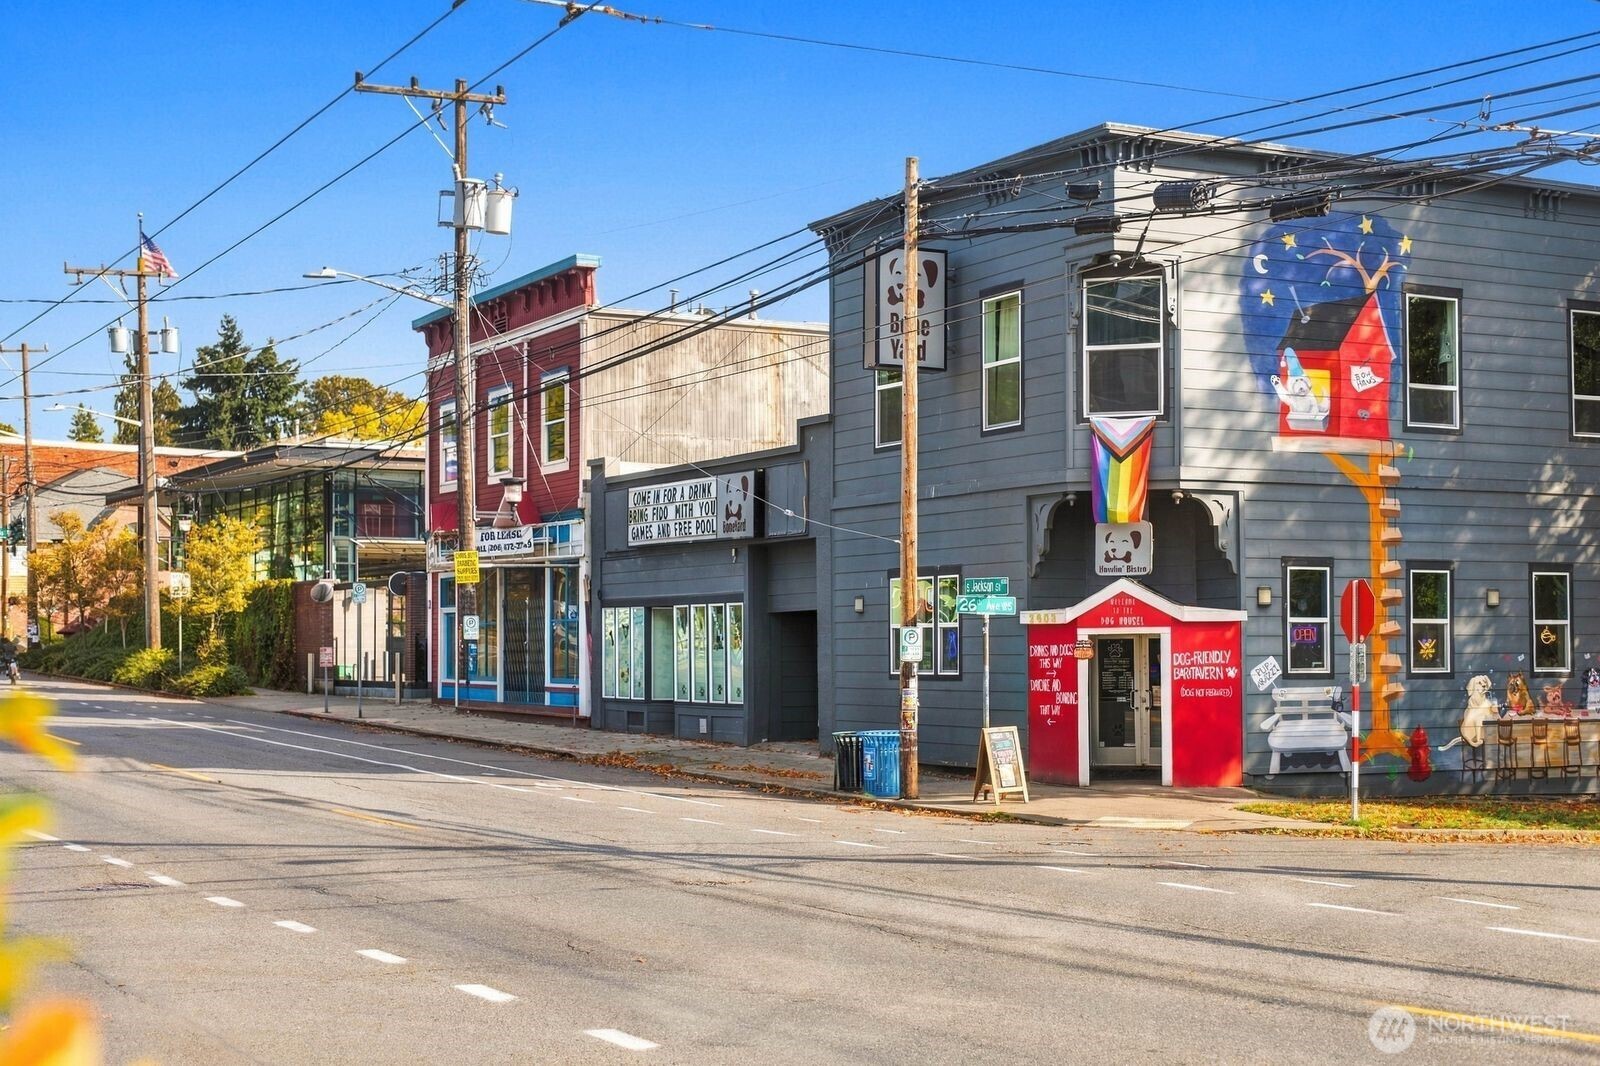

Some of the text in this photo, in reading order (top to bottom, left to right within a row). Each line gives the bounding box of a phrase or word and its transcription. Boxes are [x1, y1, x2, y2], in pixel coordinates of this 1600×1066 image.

[633, 482, 712, 506] COME IN FOR A DRINK
[629, 509, 648, 524] BRING
[651, 505, 669, 520] FIDO
[700, 499, 716, 516] YOU
[631, 518, 716, 541] GAMES AND FREE POOL
[480, 530, 522, 542] FOR LEASE
[457, 567, 477, 575] SUPPLIES
[1098, 565, 1147, 573] Howlin' Bistro
[966, 583, 970, 592] S
[972, 579, 994, 592] Jackson
[1110, 598, 1136, 606] WELCOME
[1100, 617, 1114, 626] DOG
[1295, 628, 1316, 641] OPEN
[1029, 645, 1049, 657] DRINKS
[1039, 657, 1063, 668] THIS WAY
[1173, 649, 1231, 666] DOG-FRIENDLY
[1196, 688, 1205, 697] NOT
[1040, 705, 1051, 715] THAT
